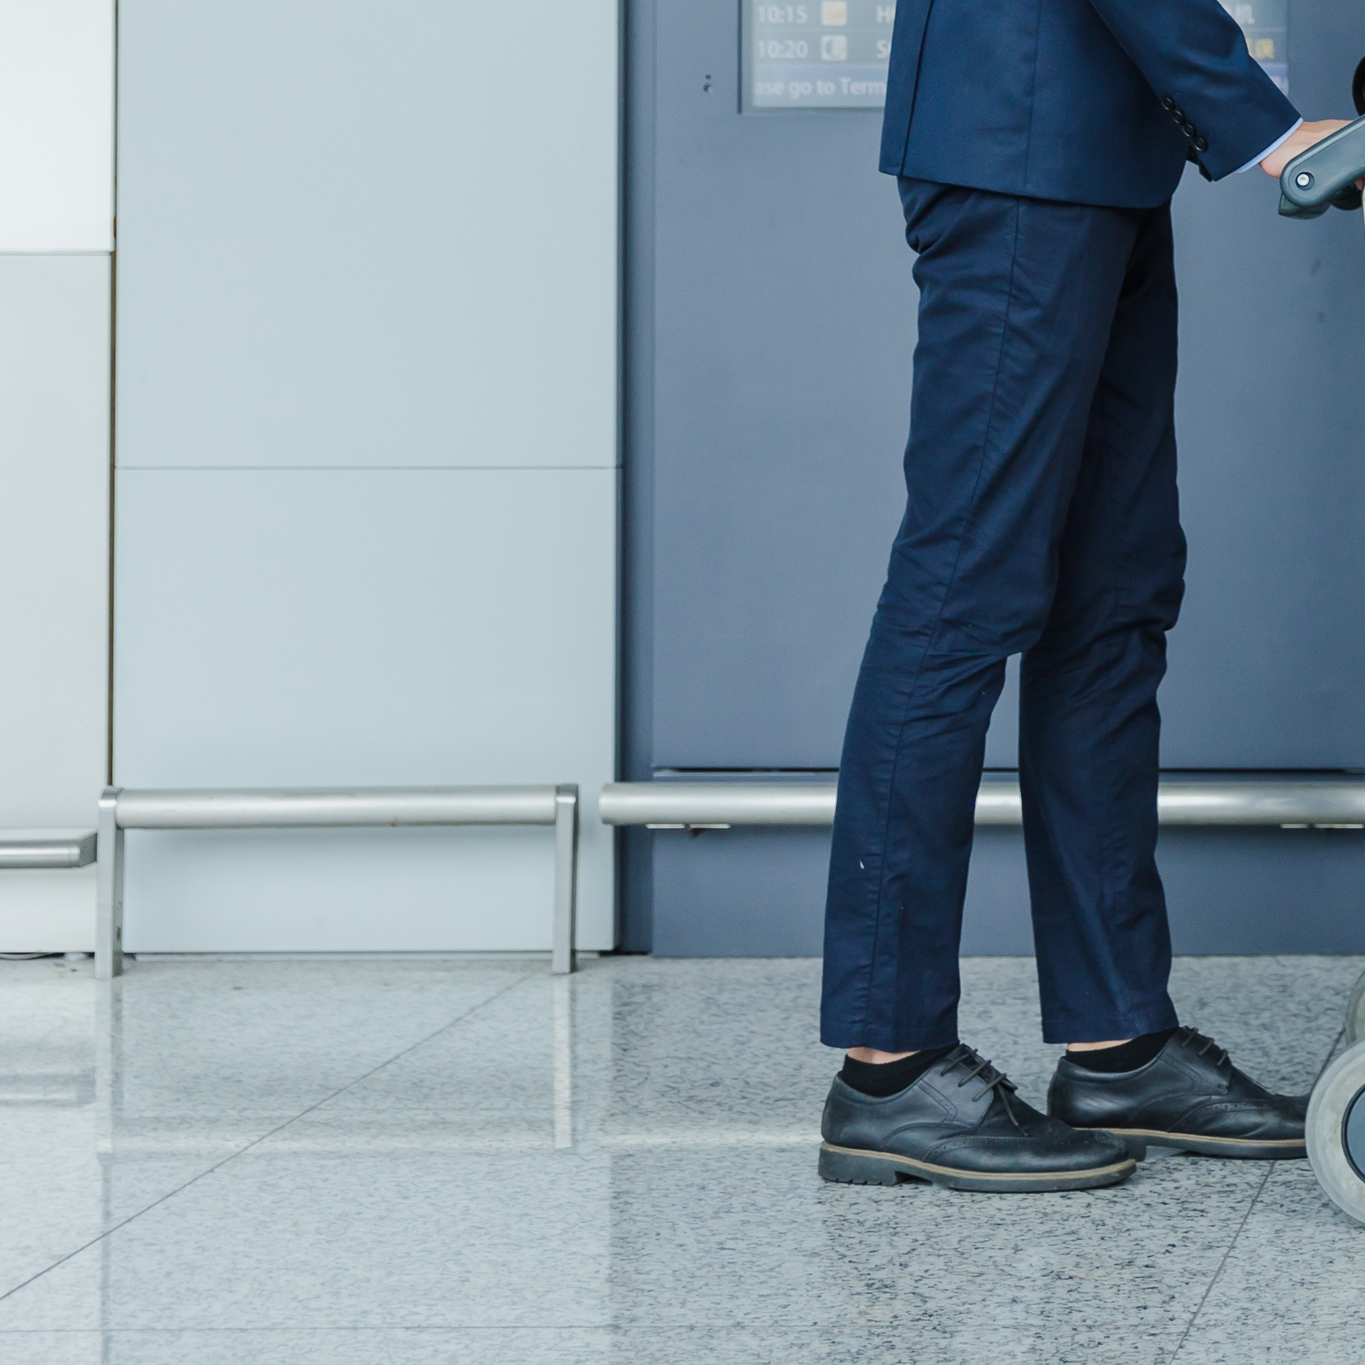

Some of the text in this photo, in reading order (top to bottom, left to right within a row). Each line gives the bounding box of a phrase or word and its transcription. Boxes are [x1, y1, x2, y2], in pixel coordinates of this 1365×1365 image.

[759, 5, 807, 23] 10:15
[758, 40, 807, 58] 10:20
[816, 80, 836, 95] to
